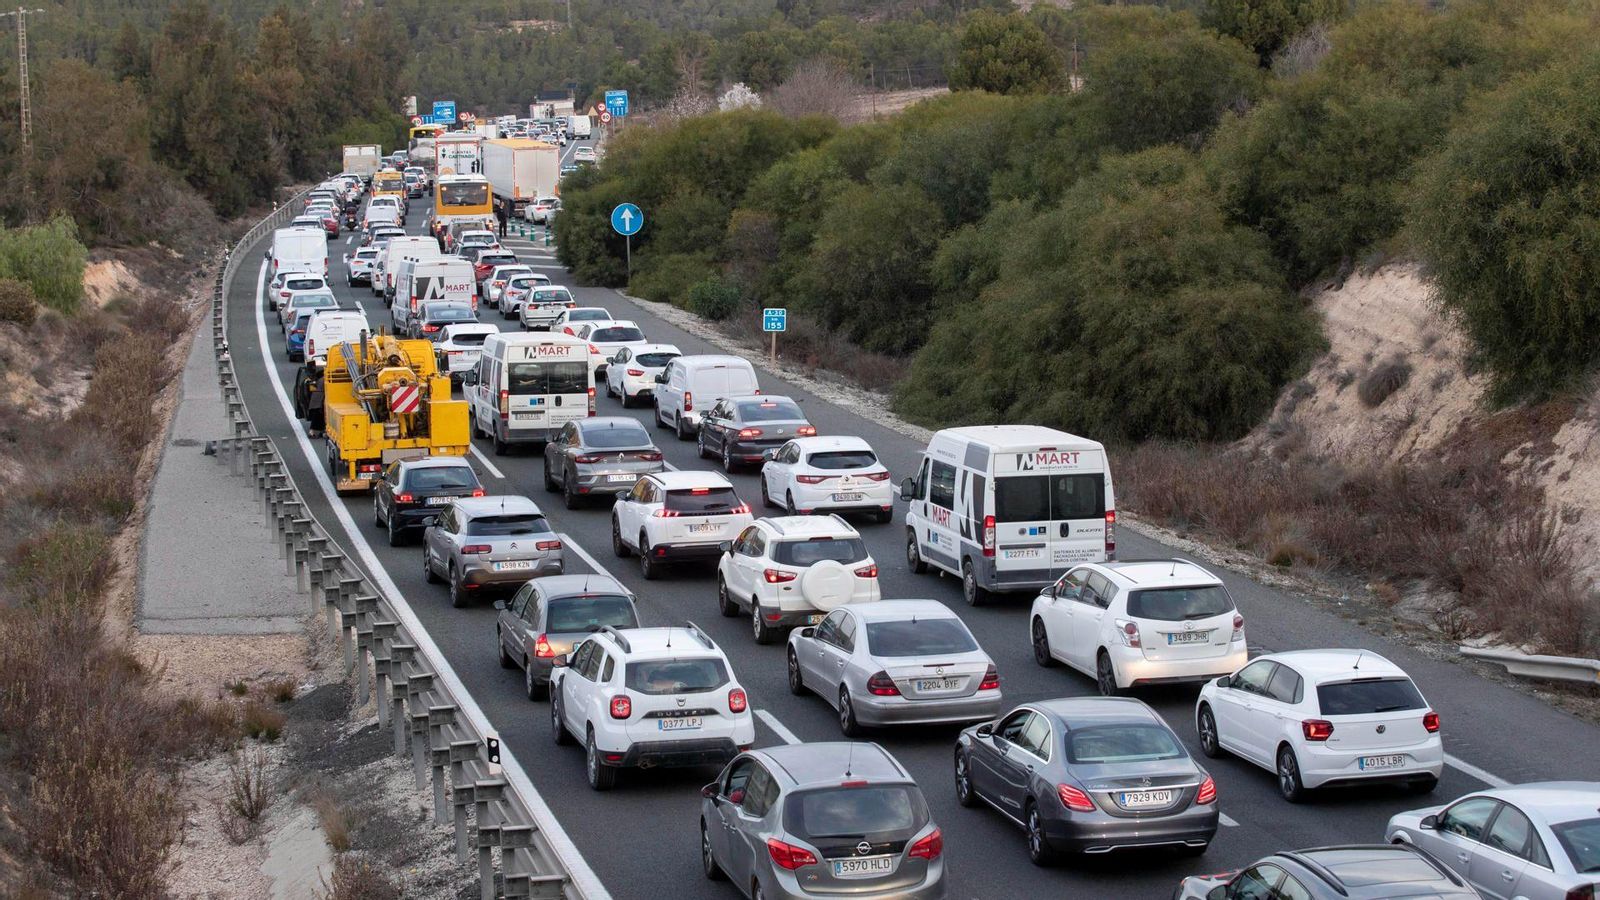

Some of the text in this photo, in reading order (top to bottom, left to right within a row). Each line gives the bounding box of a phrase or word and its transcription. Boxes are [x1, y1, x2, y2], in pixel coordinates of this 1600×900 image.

[445, 283, 471, 291] MART
[538, 346, 571, 355] MART
[1035, 452, 1080, 465] MART
[932, 505, 951, 528] MART
[1009, 548, 1039, 558] 2277 FTV
[1173, 632, 1207, 641] 3489 JHR
[923, 680, 958, 689] 2204 BYF
[663, 718, 703, 728] 0377 LPJ
[1364, 756, 1403, 767] 4015 LBR
[1126, 791, 1170, 802] 7929 KDV
[842, 858, 890, 871] 5970 HLD
